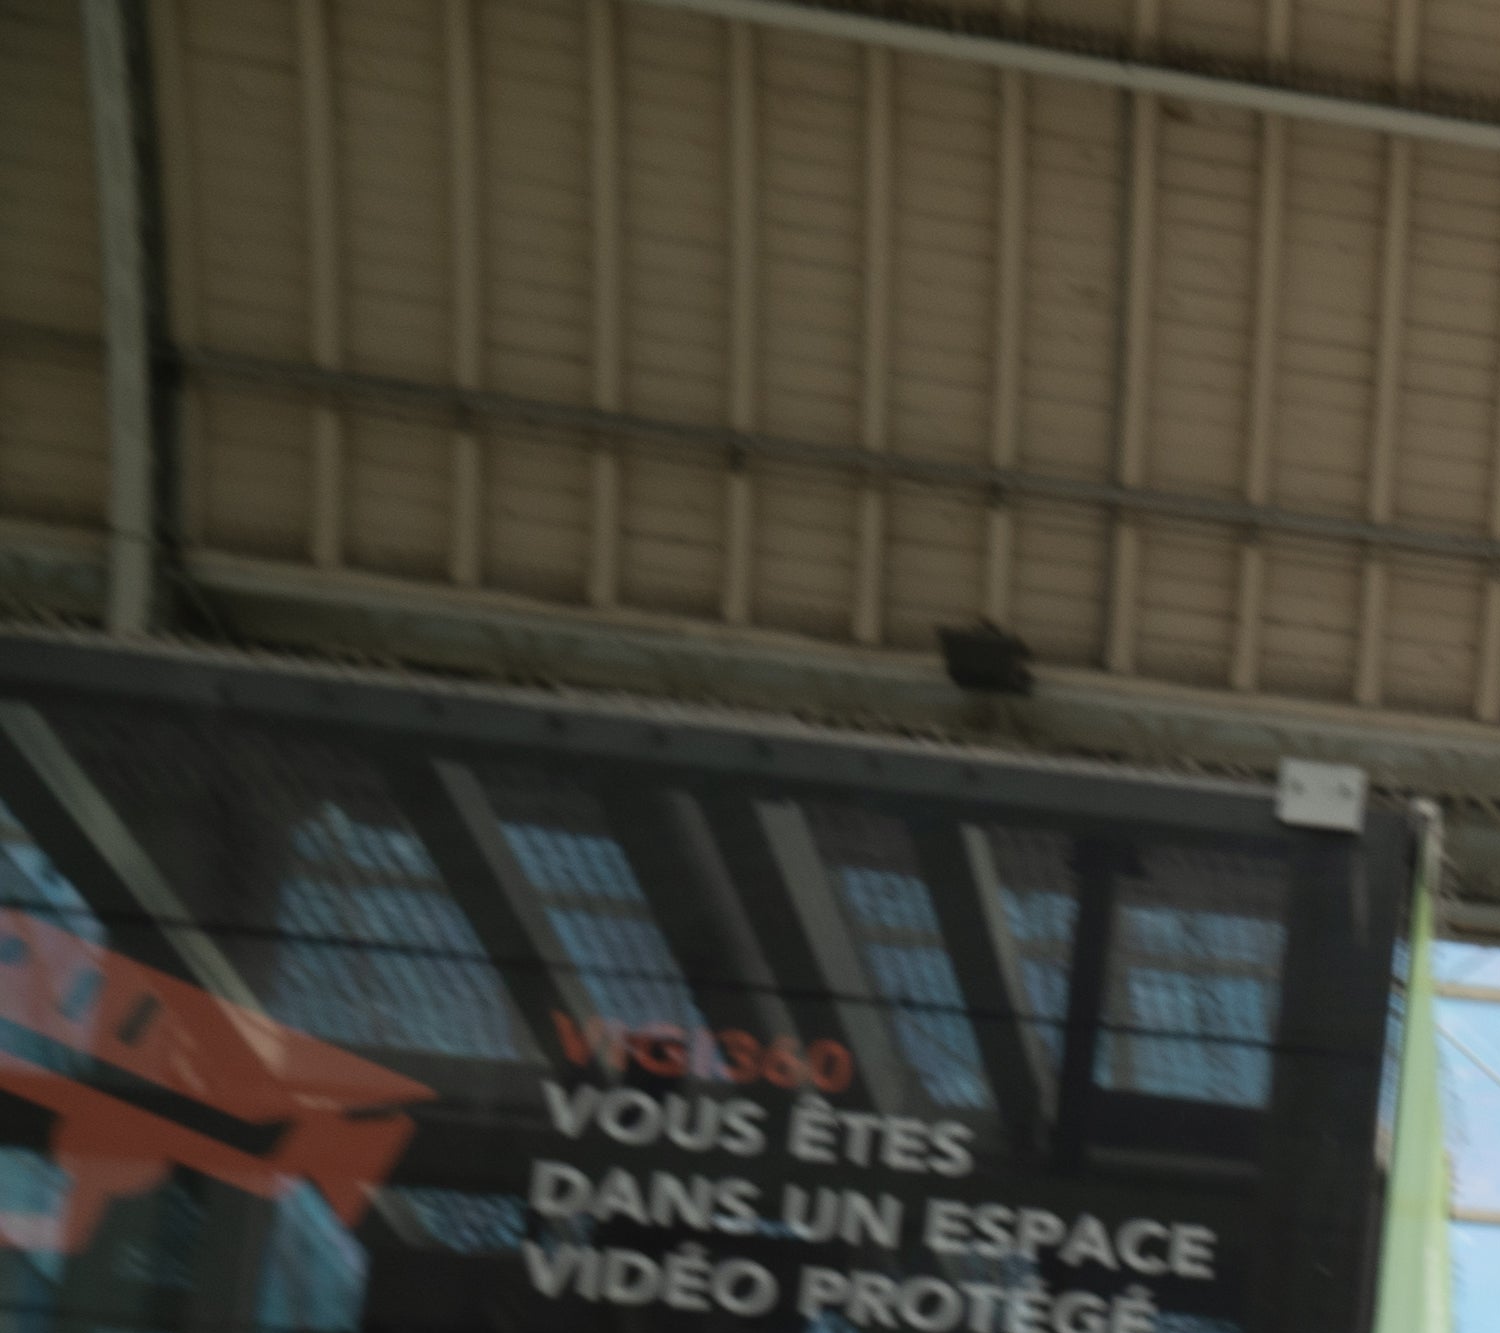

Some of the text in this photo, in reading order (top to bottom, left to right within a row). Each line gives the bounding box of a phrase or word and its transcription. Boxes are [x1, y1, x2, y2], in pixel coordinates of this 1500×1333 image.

[544, 1082, 975, 1175] VOUS ÊTES
[528, 1159, 1219, 1280] DANS UN ESPACE
[524, 1240, 780, 1317] VIDÉO
